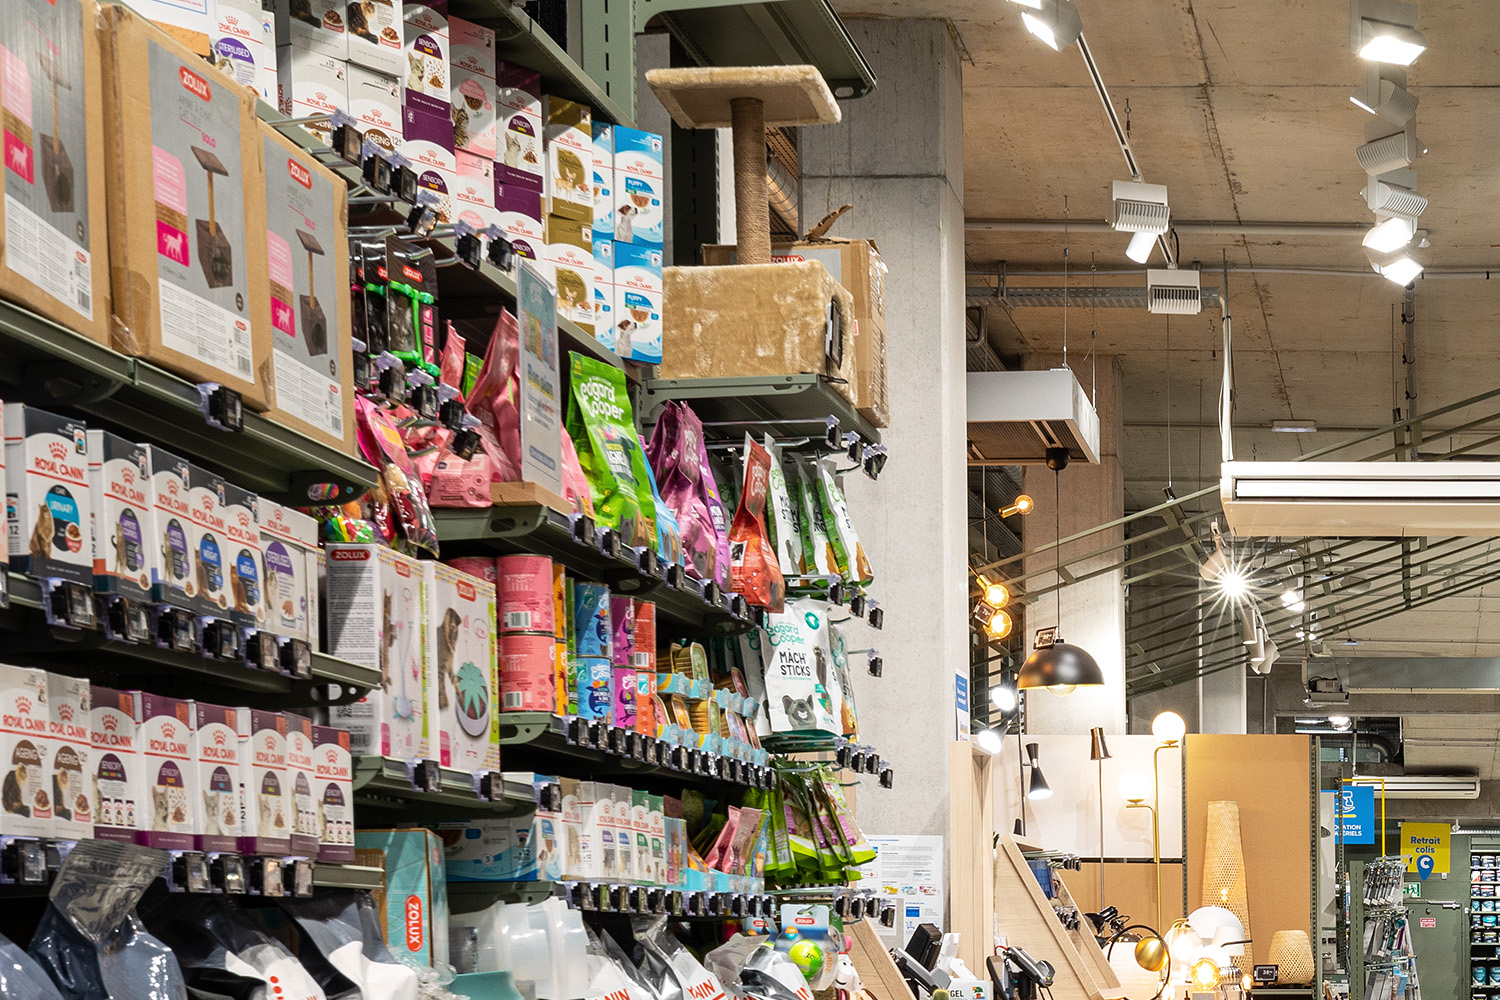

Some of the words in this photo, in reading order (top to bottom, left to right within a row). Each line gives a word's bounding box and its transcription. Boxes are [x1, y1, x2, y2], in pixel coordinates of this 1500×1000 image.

[418, 38, 438, 50] SENSORY
[183, 70, 208, 96] ZOLUX
[365, 133, 390, 146] AGEING
[290, 163, 310, 186] ZOLUX
[422, 174, 443, 185] SENSORY
[34, 457, 58, 473] ROYAL
[60, 464, 84, 480] CANIN
[781, 664, 811, 677] STICKS
[3, 715, 24, 729] ROYAL
[25, 718, 46, 732] CANIN
[1410, 836, 1441, 845] Retrait
[408, 903, 421, 944] ZOLUX
